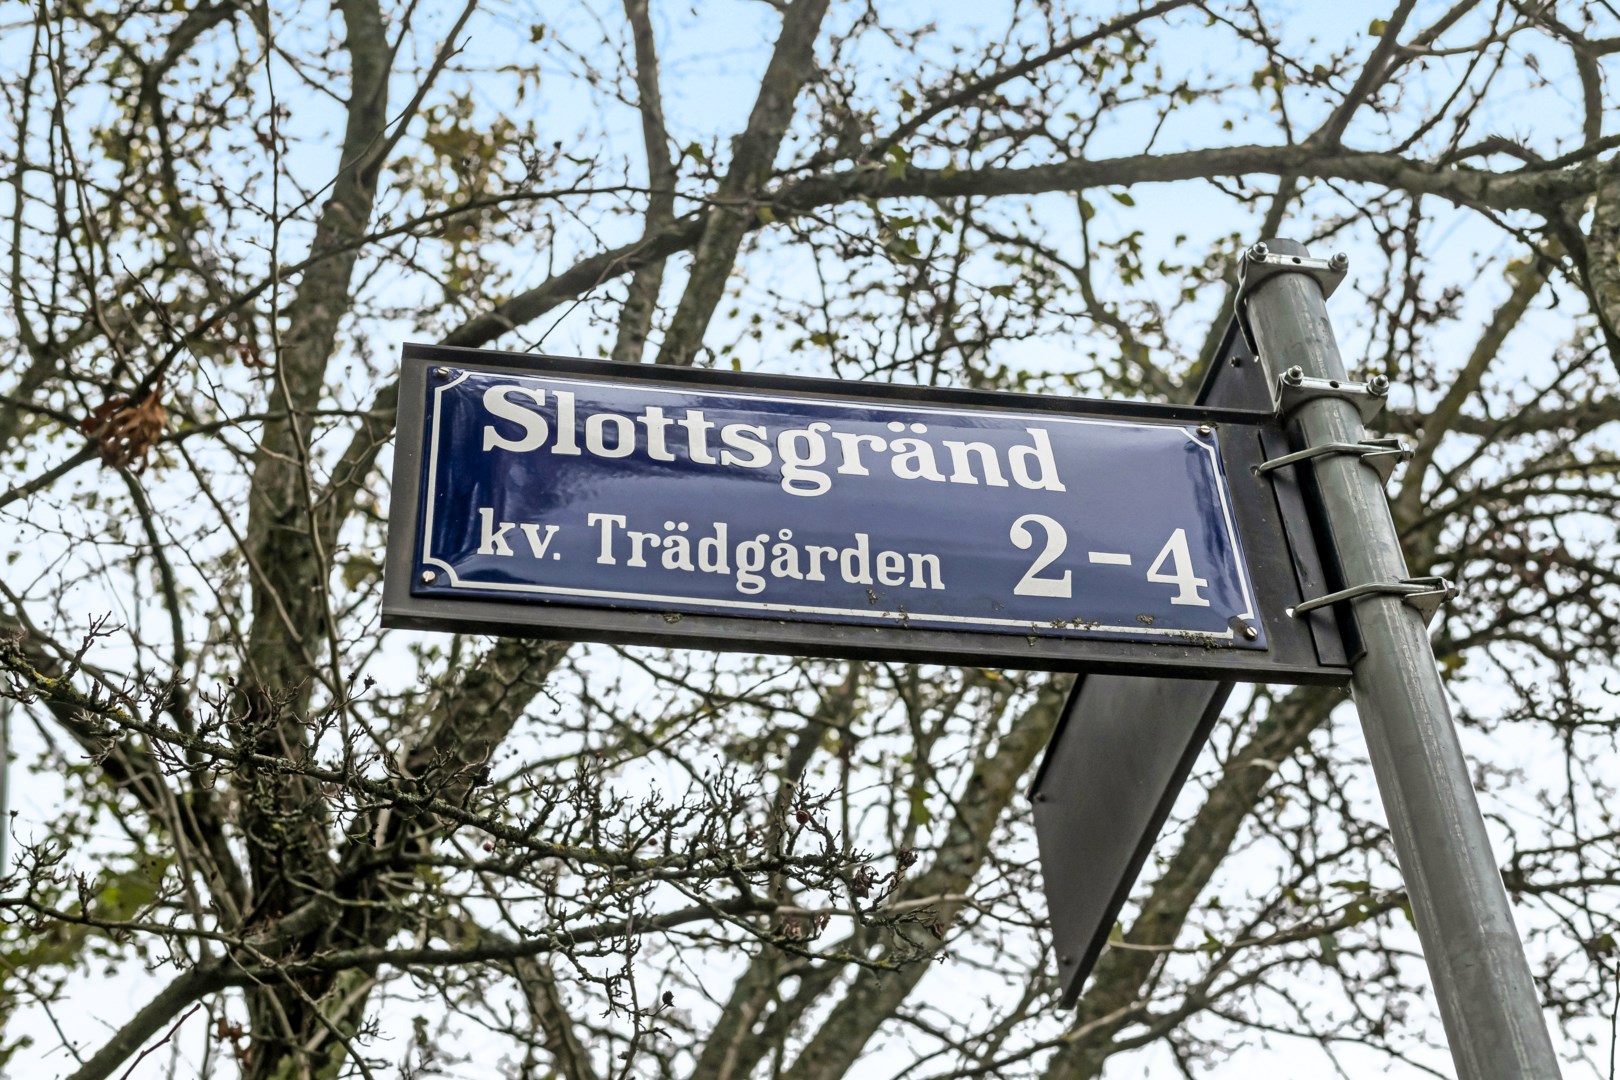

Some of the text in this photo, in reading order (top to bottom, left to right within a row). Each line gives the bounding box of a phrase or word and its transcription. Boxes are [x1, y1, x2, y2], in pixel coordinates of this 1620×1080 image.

[482, 384, 1067, 497] Slottsgränd
[476, 507, 562, 561] kv.
[587, 512, 946, 595] Trädgården
